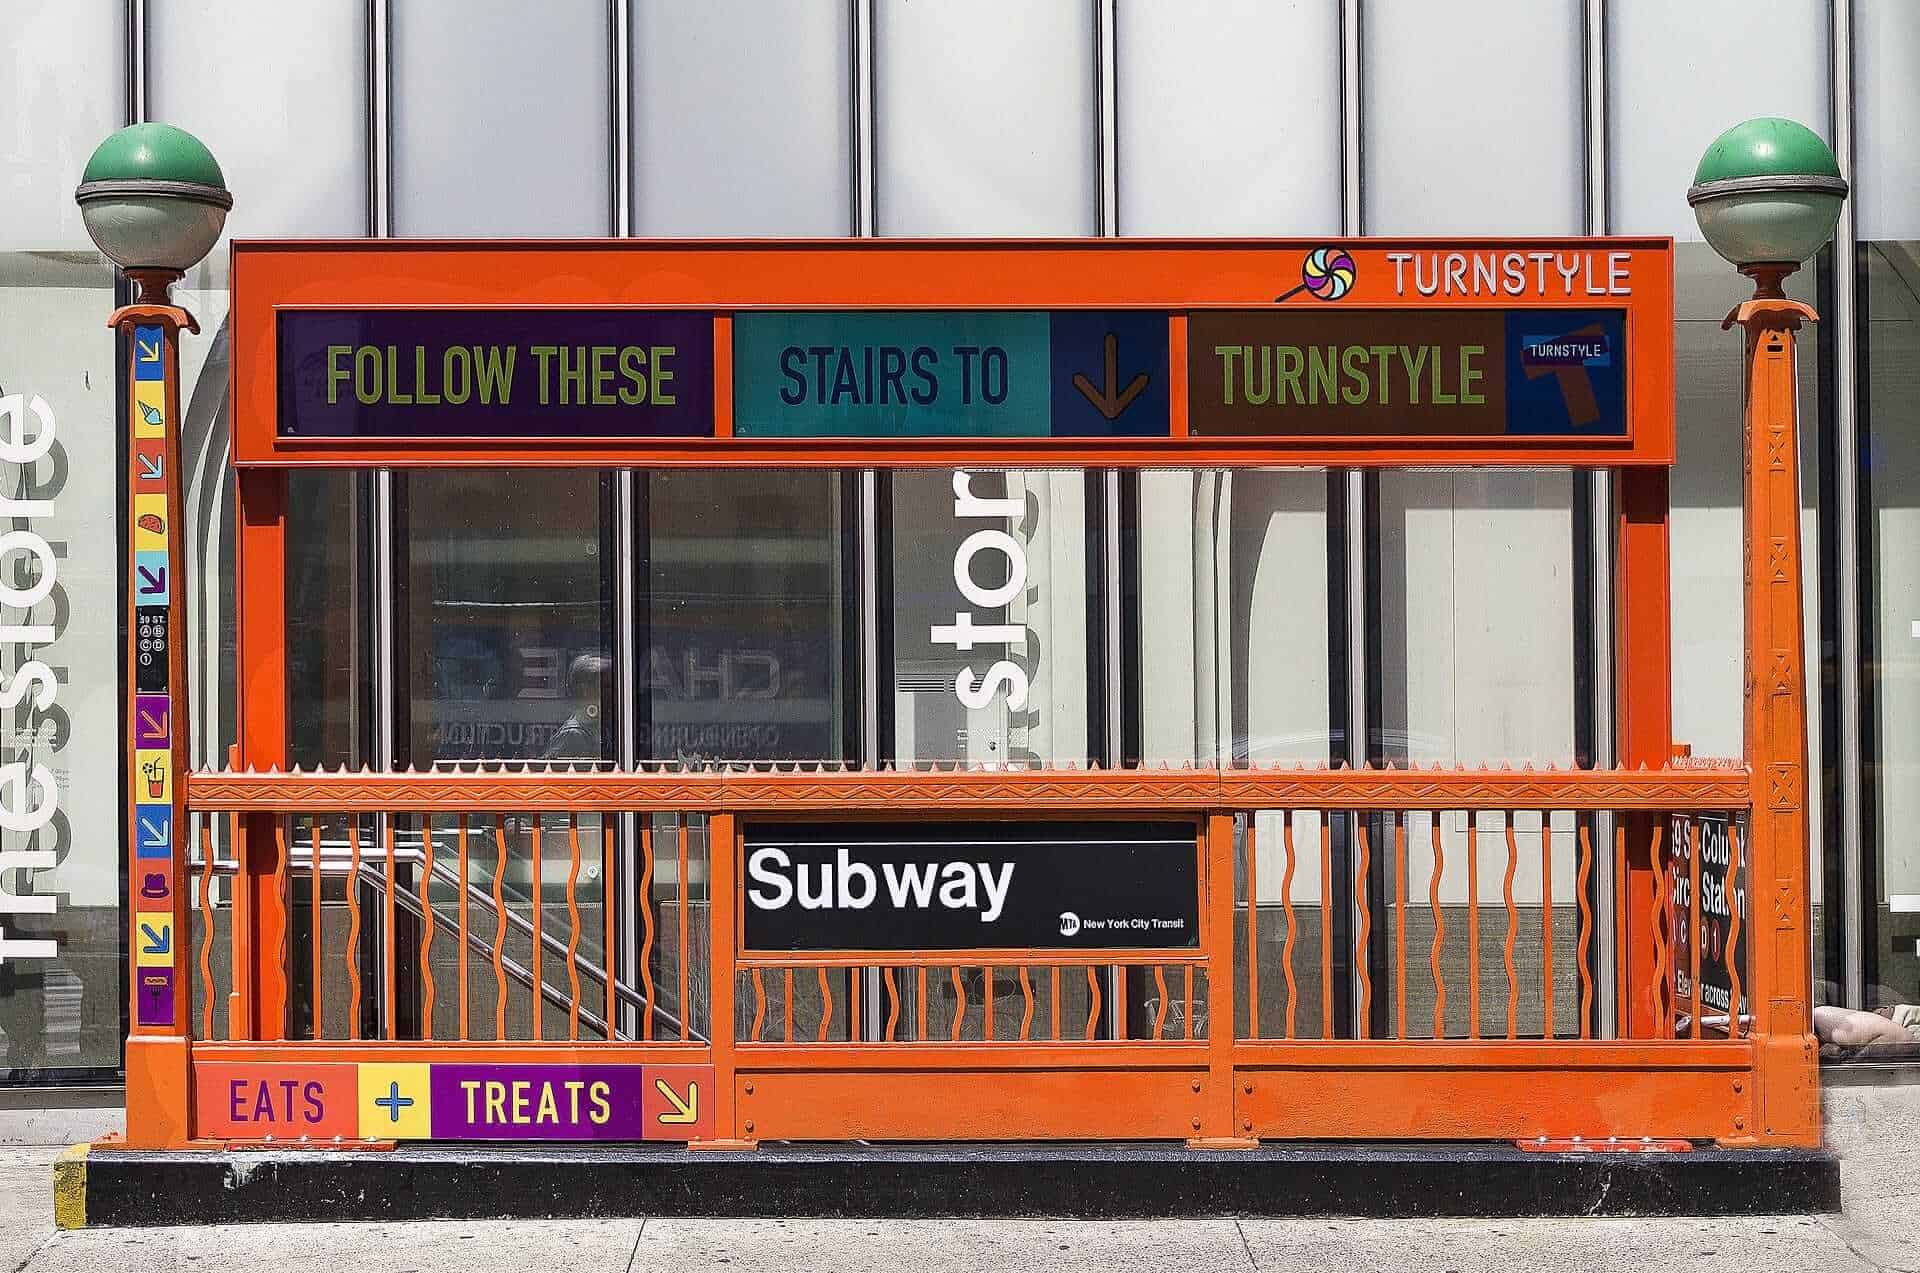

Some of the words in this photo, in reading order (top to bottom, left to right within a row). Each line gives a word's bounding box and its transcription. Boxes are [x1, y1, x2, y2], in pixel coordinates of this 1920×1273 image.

[1387, 252, 1632, 297] TURNSTYLE
[1530, 343, 1601, 358] TURNSTYLE
[327, 345, 517, 405] FOLLOW
[531, 345, 677, 406] THESE
[779, 345, 939, 406] STAIRS
[953, 345, 1009, 406] TO
[1216, 345, 1485, 406] TURNSTYLE
[747, 847, 1016, 923] Subway
[1083, 919, 1105, 929] New
[1107, 918, 1130, 929] York
[1131, 918, 1150, 931] City
[1151, 918, 1185, 929] Transit
[1705, 983, 1729, 1009] across
[230, 1079, 325, 1124] EATS
[460, 1080, 611, 1126] TREATS
